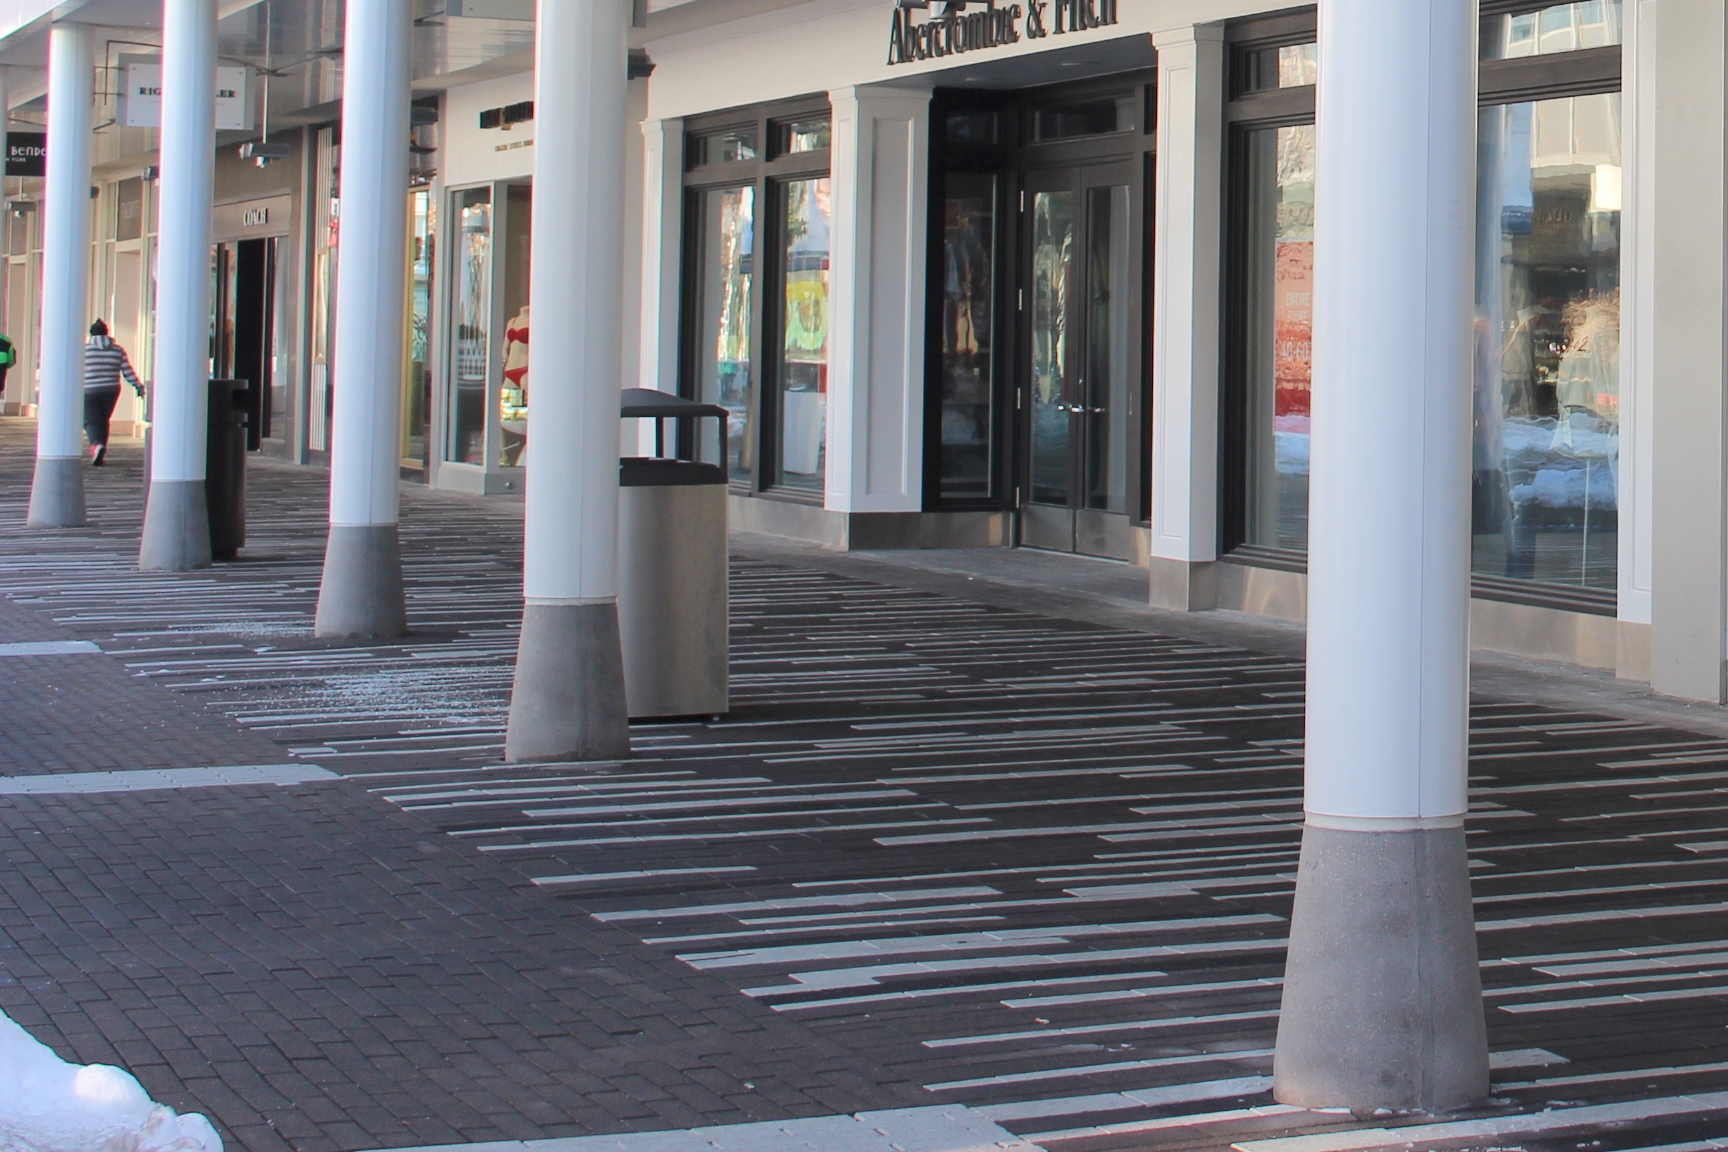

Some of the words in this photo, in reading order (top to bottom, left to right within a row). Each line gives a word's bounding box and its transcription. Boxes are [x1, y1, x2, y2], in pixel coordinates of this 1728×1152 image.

[139, 86, 161, 96] RIG
[243, 207, 268, 226] COACH
[1286, 292, 1310, 306] ENTIRE
